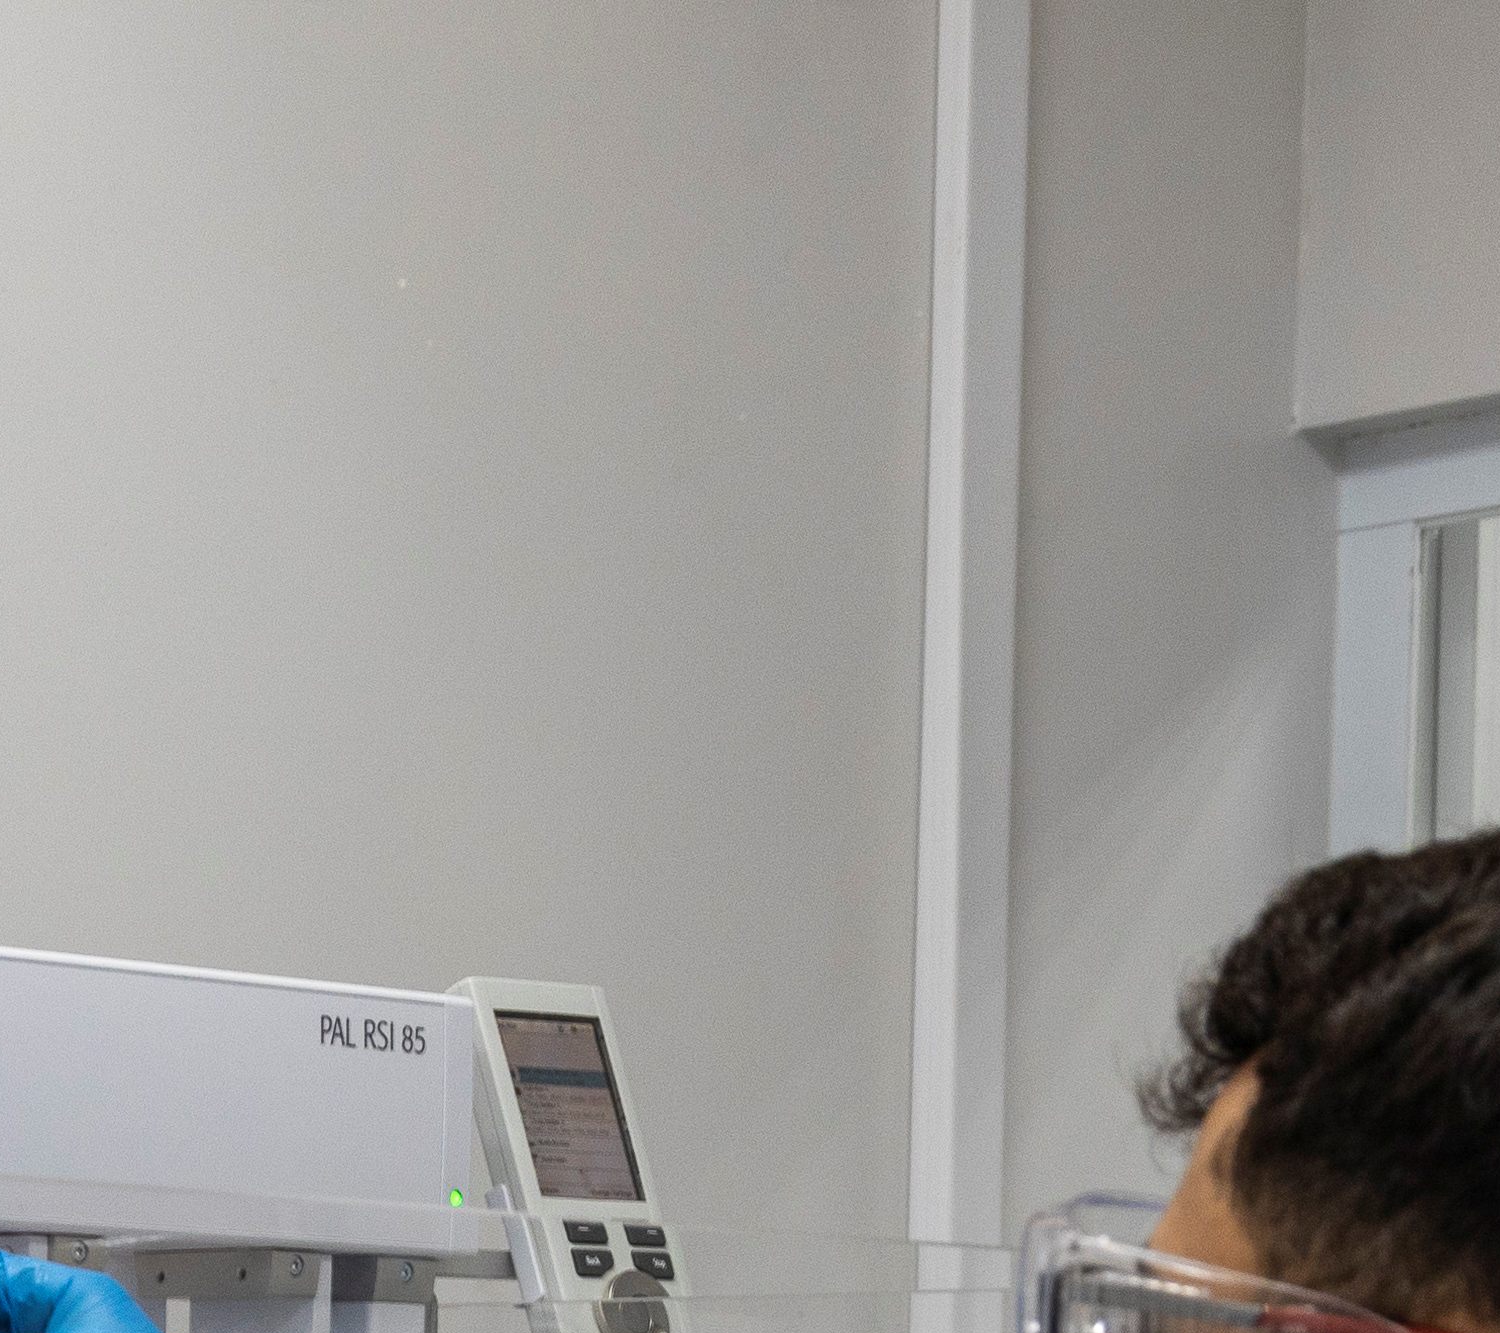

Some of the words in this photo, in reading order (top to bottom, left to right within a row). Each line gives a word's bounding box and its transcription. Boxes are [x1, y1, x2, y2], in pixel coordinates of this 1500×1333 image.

[320, 1014, 356, 1048] PAL
[363, 1018, 394, 1052] RSI
[401, 1024, 426, 1055] 85
